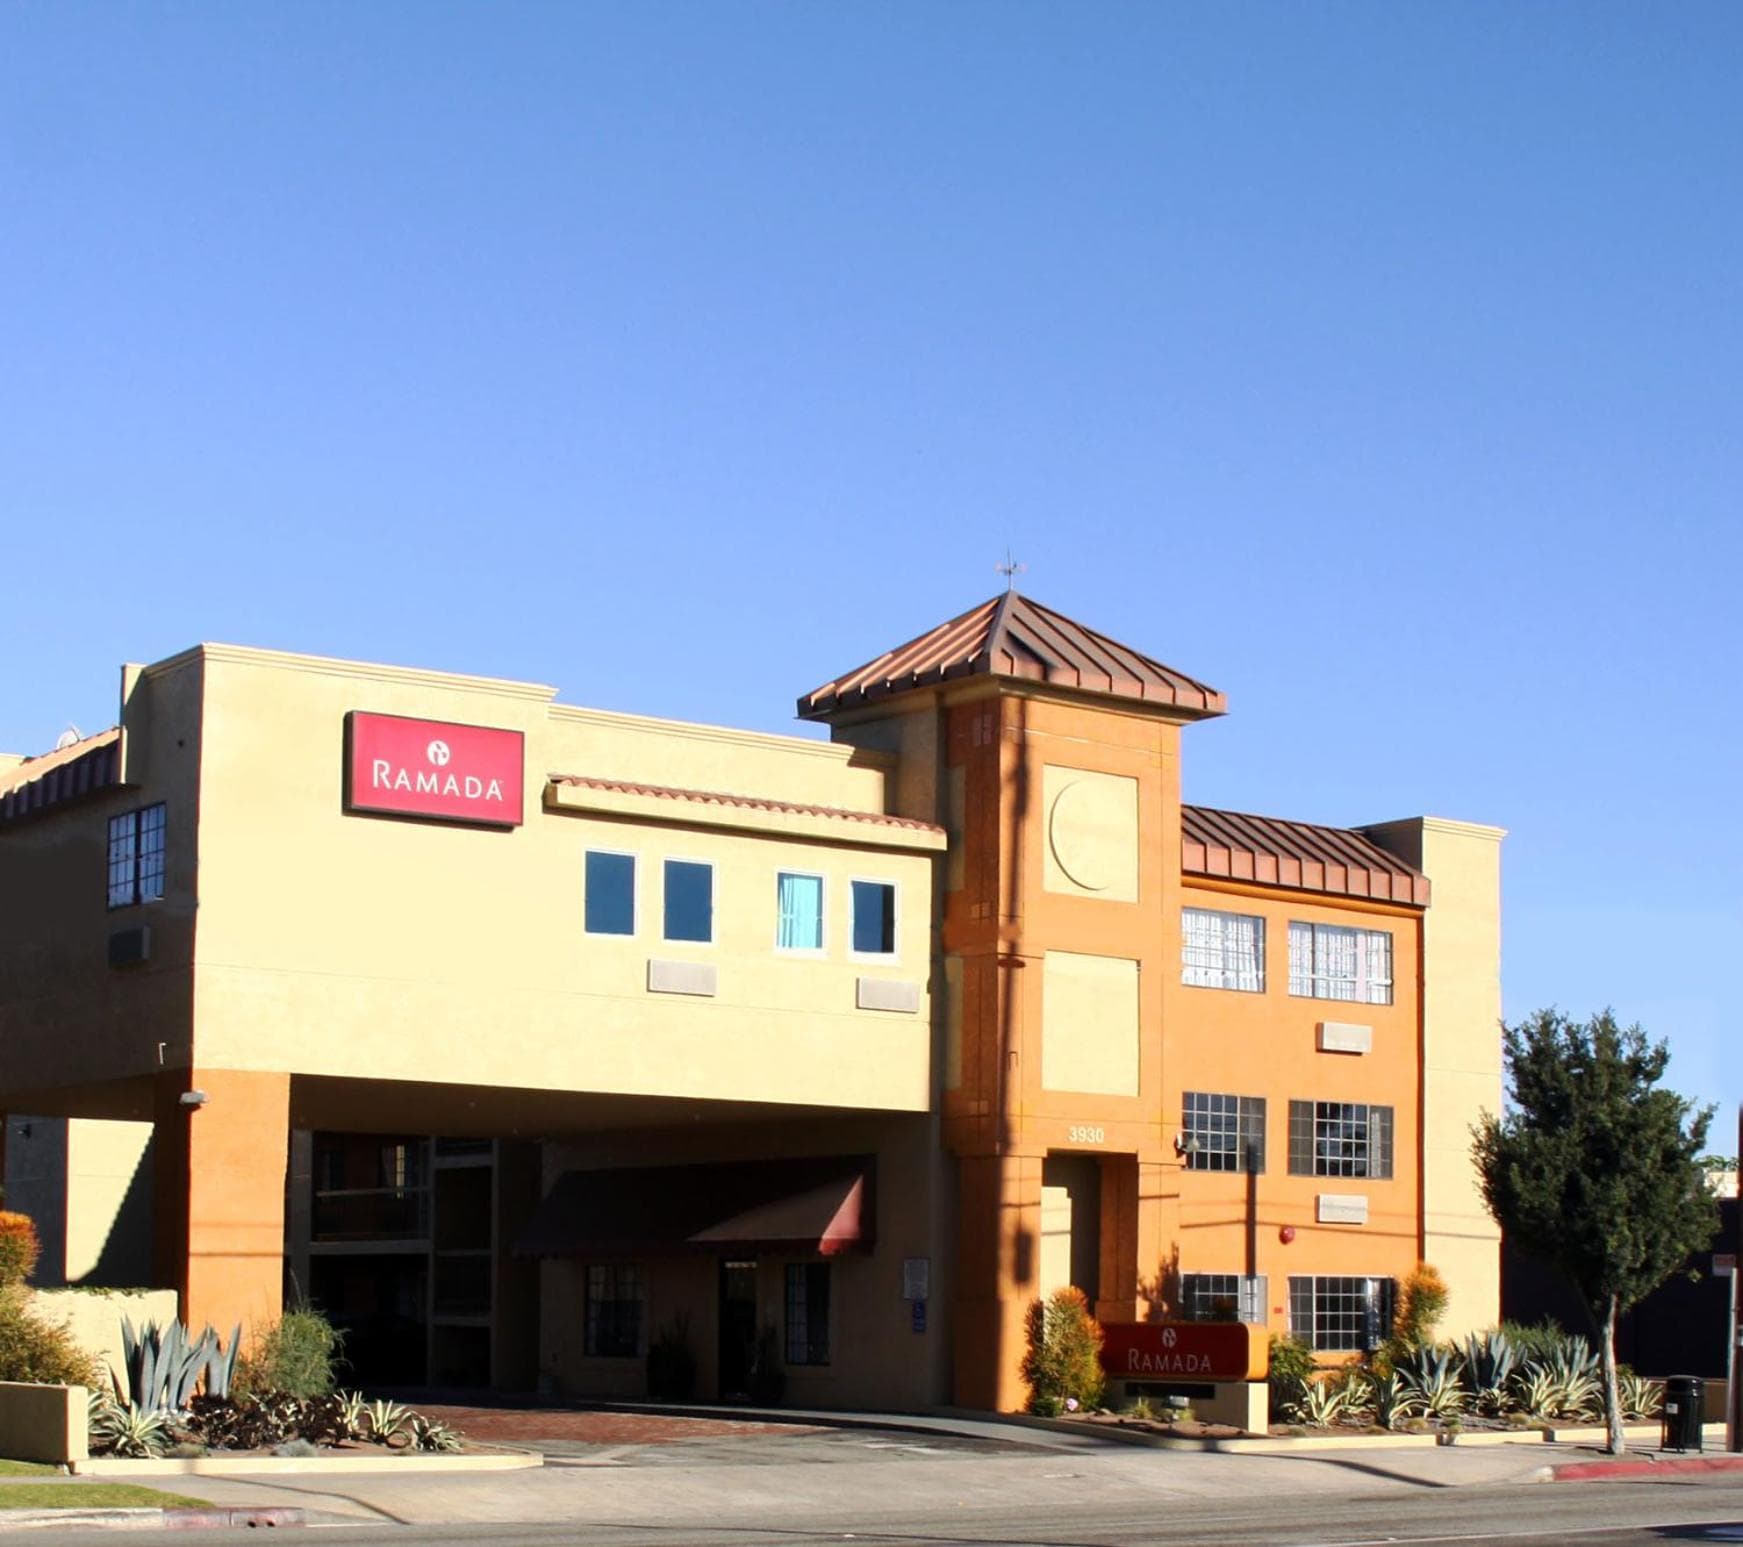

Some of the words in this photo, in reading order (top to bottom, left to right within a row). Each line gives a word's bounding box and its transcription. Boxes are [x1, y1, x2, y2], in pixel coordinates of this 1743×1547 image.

[372, 759, 503, 802] RAMADA
[1068, 1125, 1105, 1144] 3930
[1127, 1347, 1212, 1373] RAMADA
